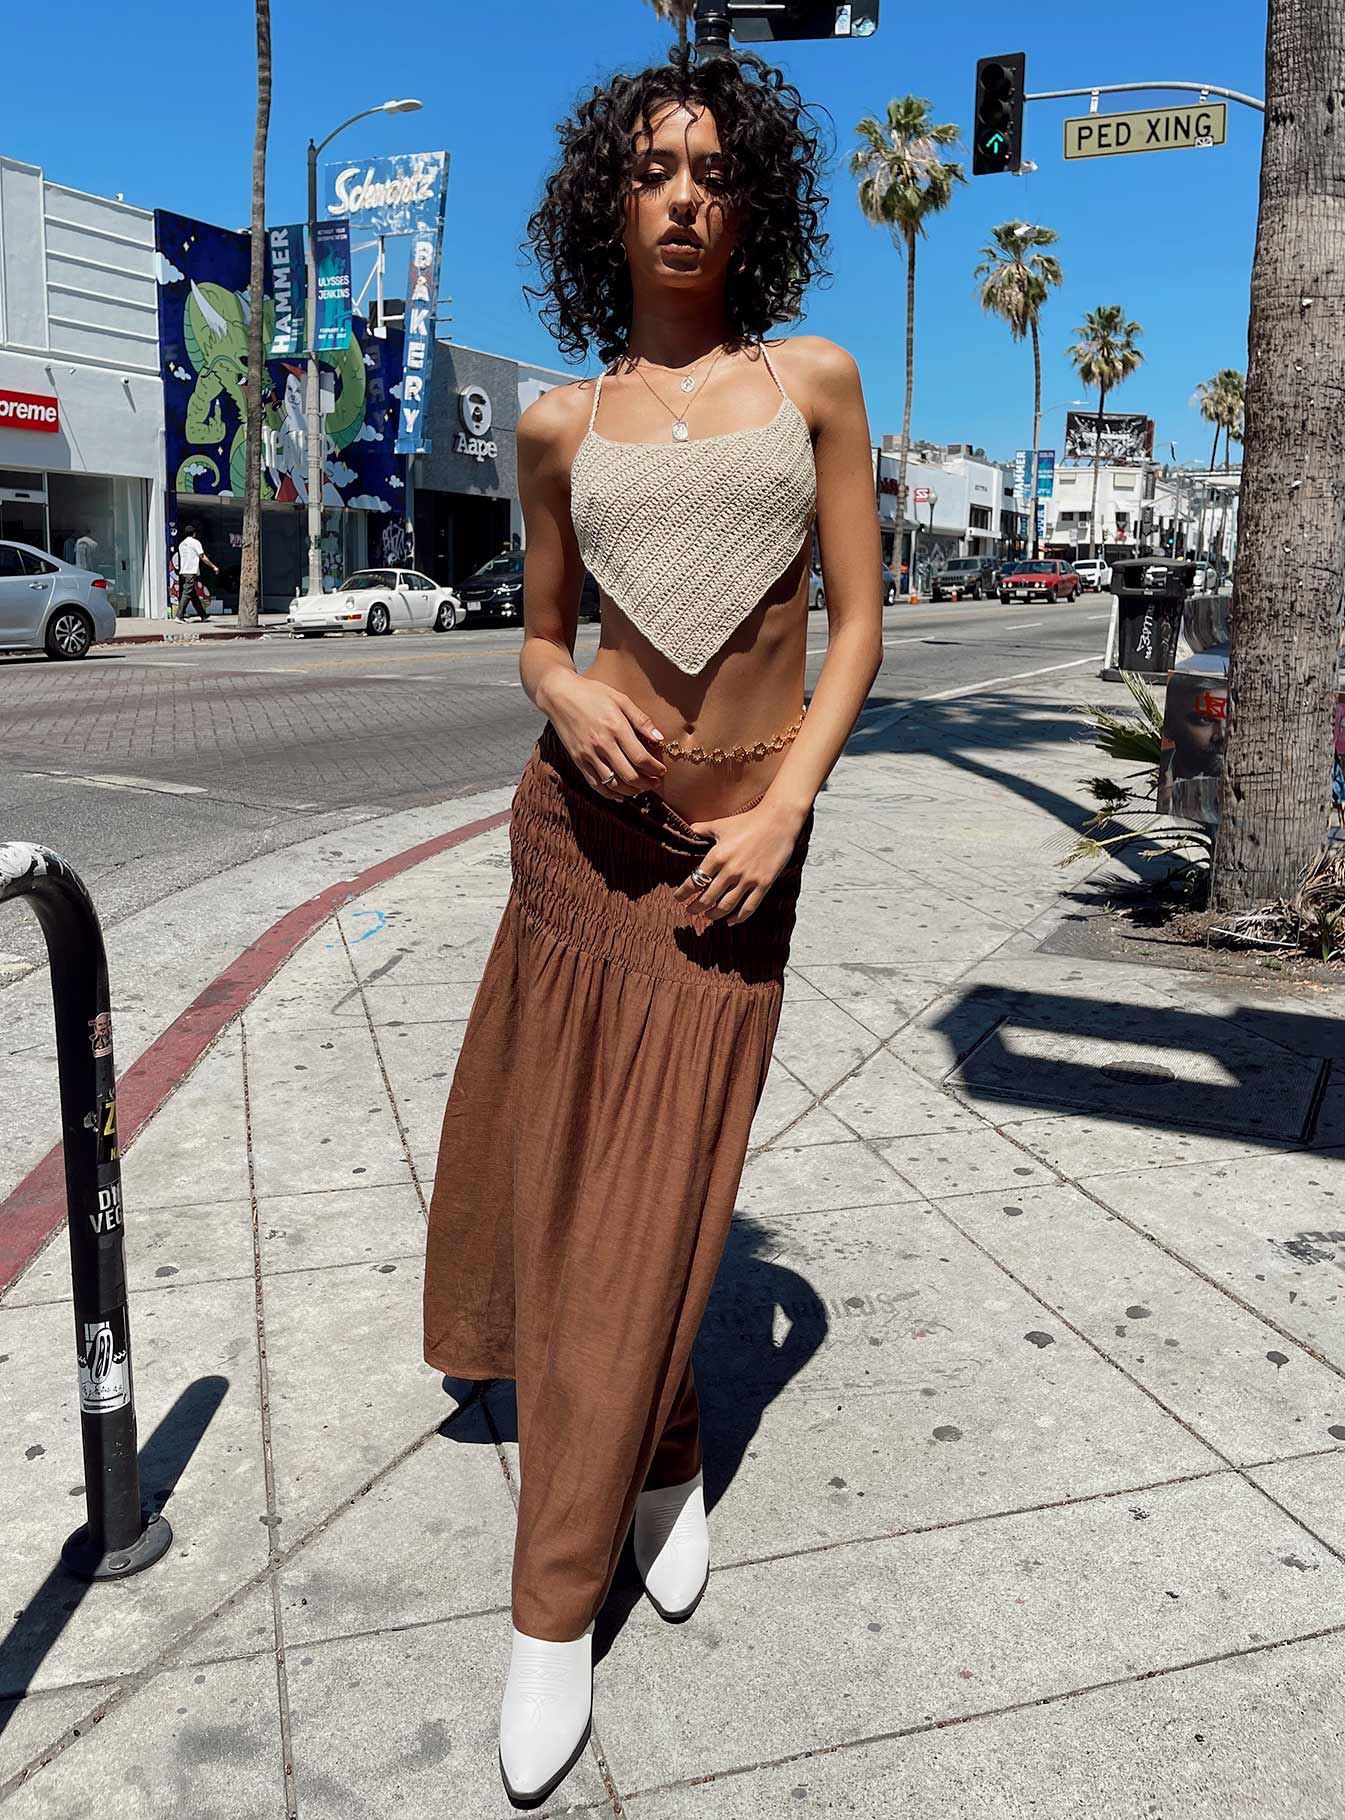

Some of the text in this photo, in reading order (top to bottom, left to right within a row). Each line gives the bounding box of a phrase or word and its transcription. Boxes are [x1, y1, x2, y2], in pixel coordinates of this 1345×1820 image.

[1077, 112, 1212, 151] PED XING
[270, 227, 292, 354] HAMMER
[318, 275, 350, 287] ULYSSES
[318, 287, 350, 300] JENKINS
[403, 241, 434, 433] BAKERY
[456, 431, 498, 462] Aape
[1013, 450, 1026, 499] HAMMER
